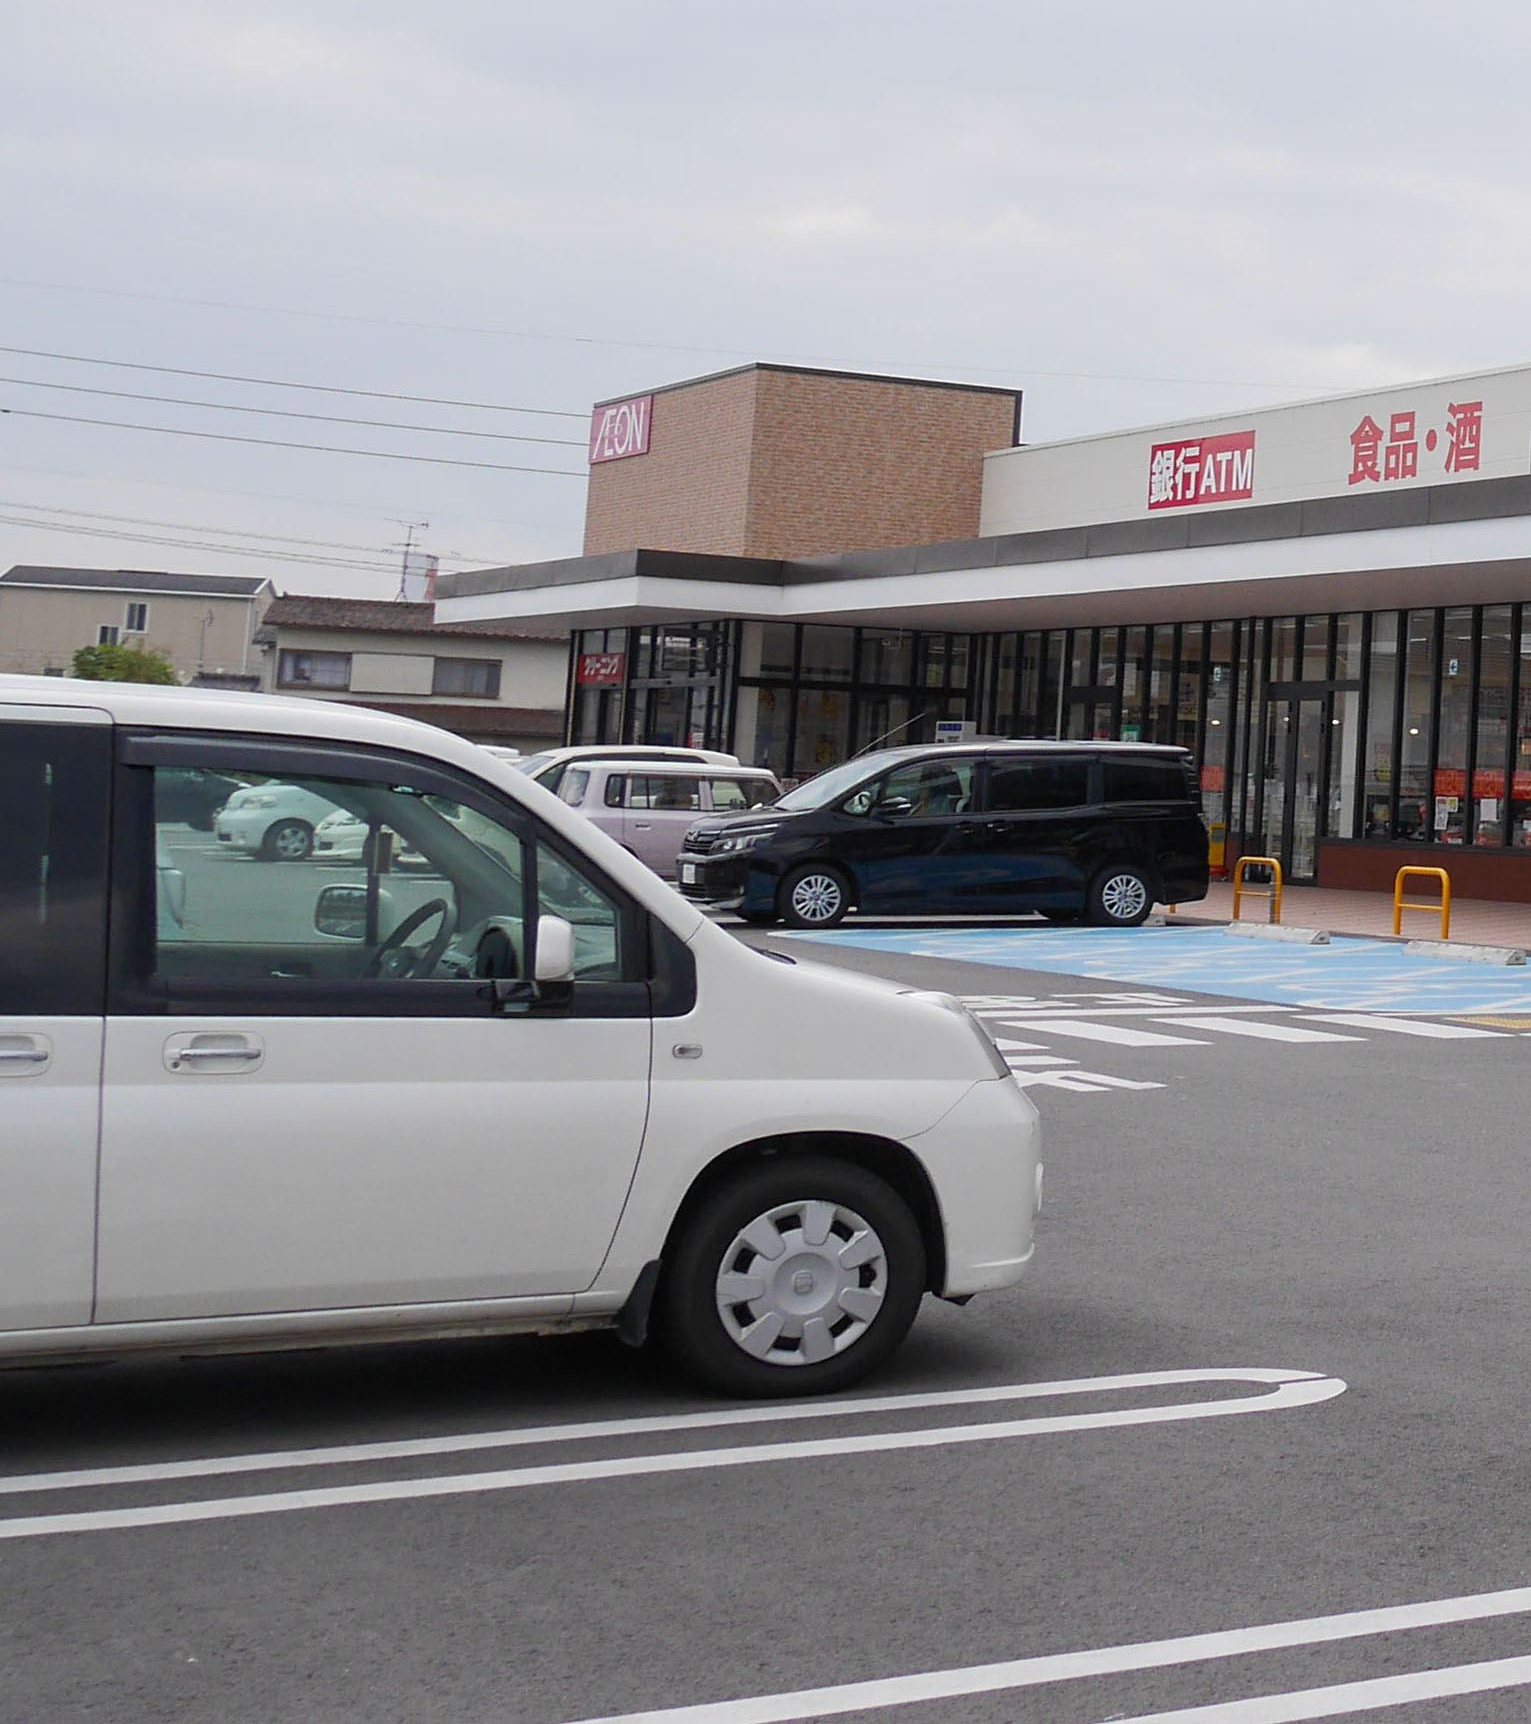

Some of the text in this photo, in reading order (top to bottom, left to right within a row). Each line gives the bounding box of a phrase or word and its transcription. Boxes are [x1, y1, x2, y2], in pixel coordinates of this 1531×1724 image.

[1150, 446, 1253, 504] 銀行ATM
[1348, 401, 1483, 485] 食品・酒
